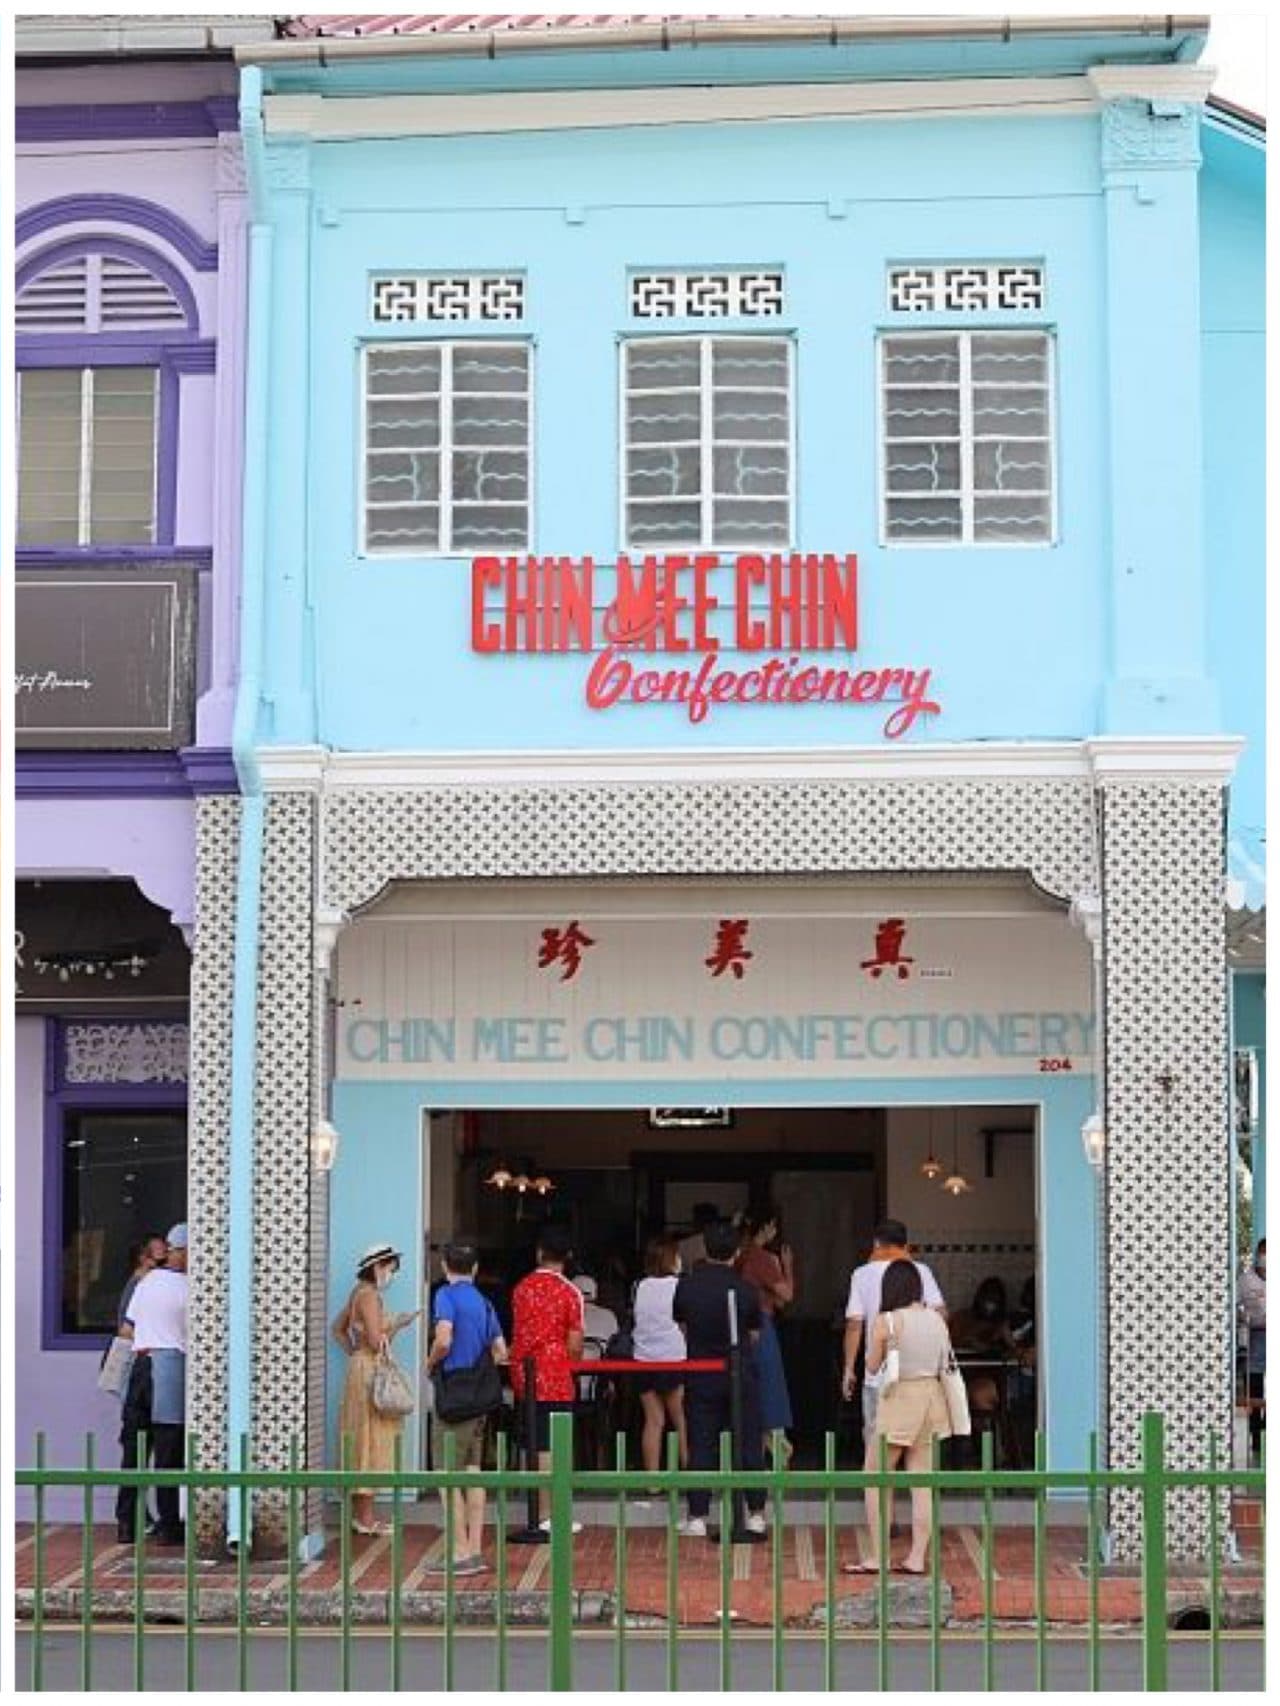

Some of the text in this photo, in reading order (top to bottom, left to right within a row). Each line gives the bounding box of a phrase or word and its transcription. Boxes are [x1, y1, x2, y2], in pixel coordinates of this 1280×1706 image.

[472, 553, 858, 653] CHIN MEE CHIN
[586, 640, 940, 739] Confectionery
[346, 1011, 1096, 1063] CHIN MEE CHIN CONFECTIONERY
[1039, 1056, 1073, 1073] 204
